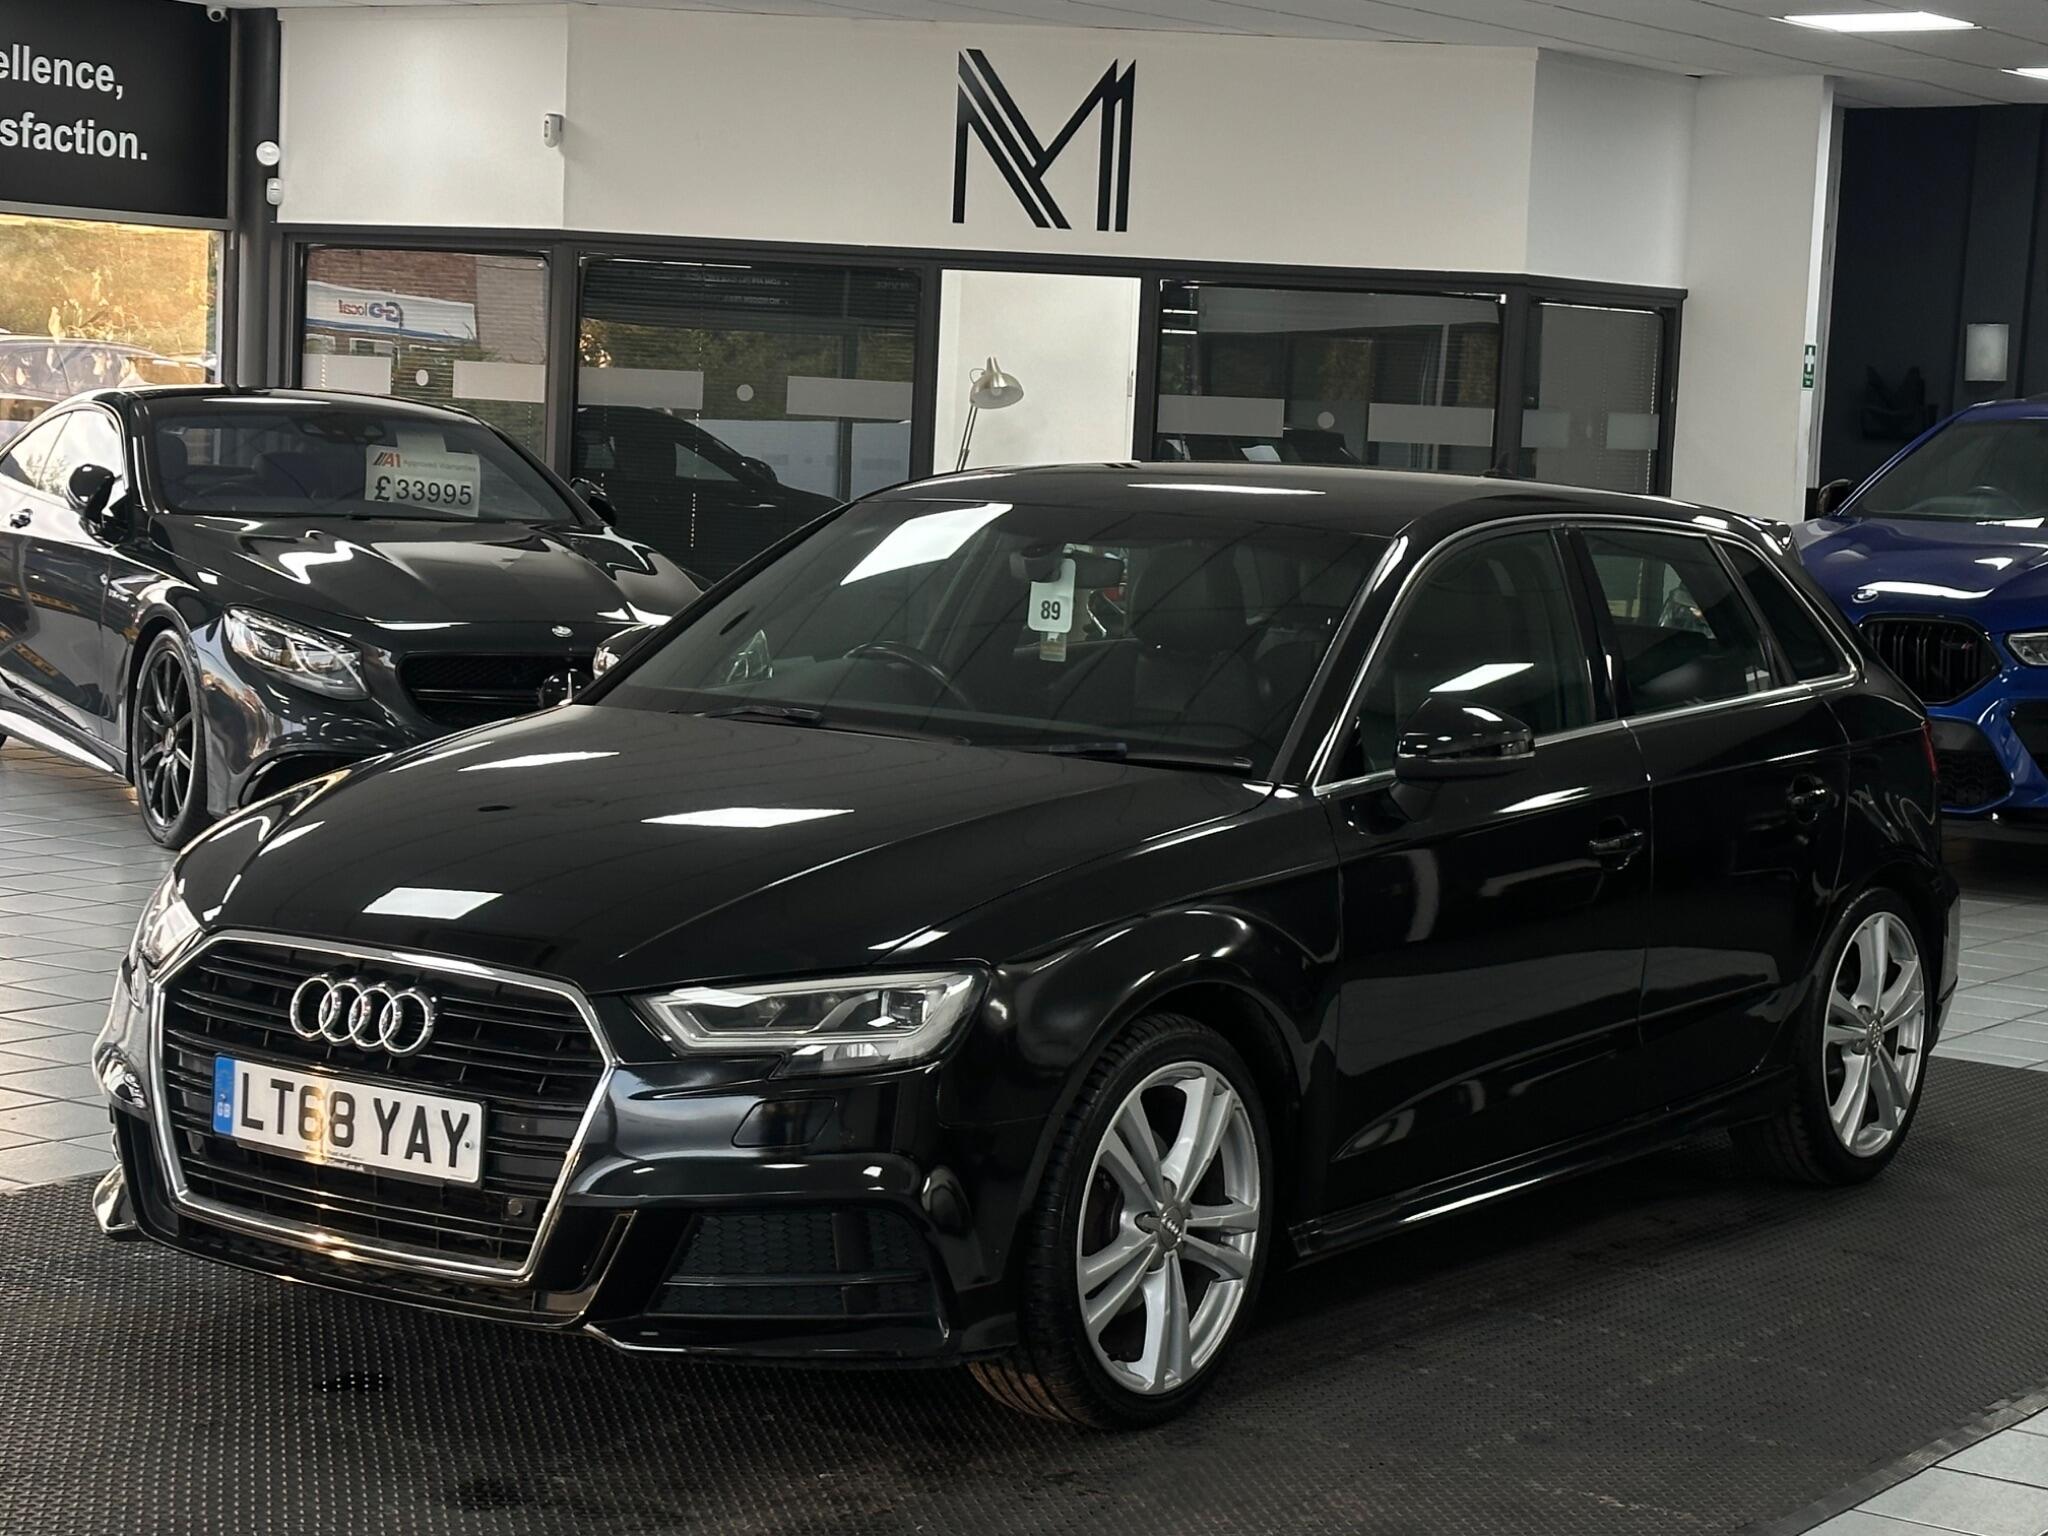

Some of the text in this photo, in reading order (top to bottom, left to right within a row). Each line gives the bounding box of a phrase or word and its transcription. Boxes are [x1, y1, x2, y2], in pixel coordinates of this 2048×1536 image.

[0, 111, 149, 161] sfaction.
[373, 475, 473, 506] £33995
[1040, 600, 1061, 621] 89
[240, 1072, 471, 1169] LT68 YAY
